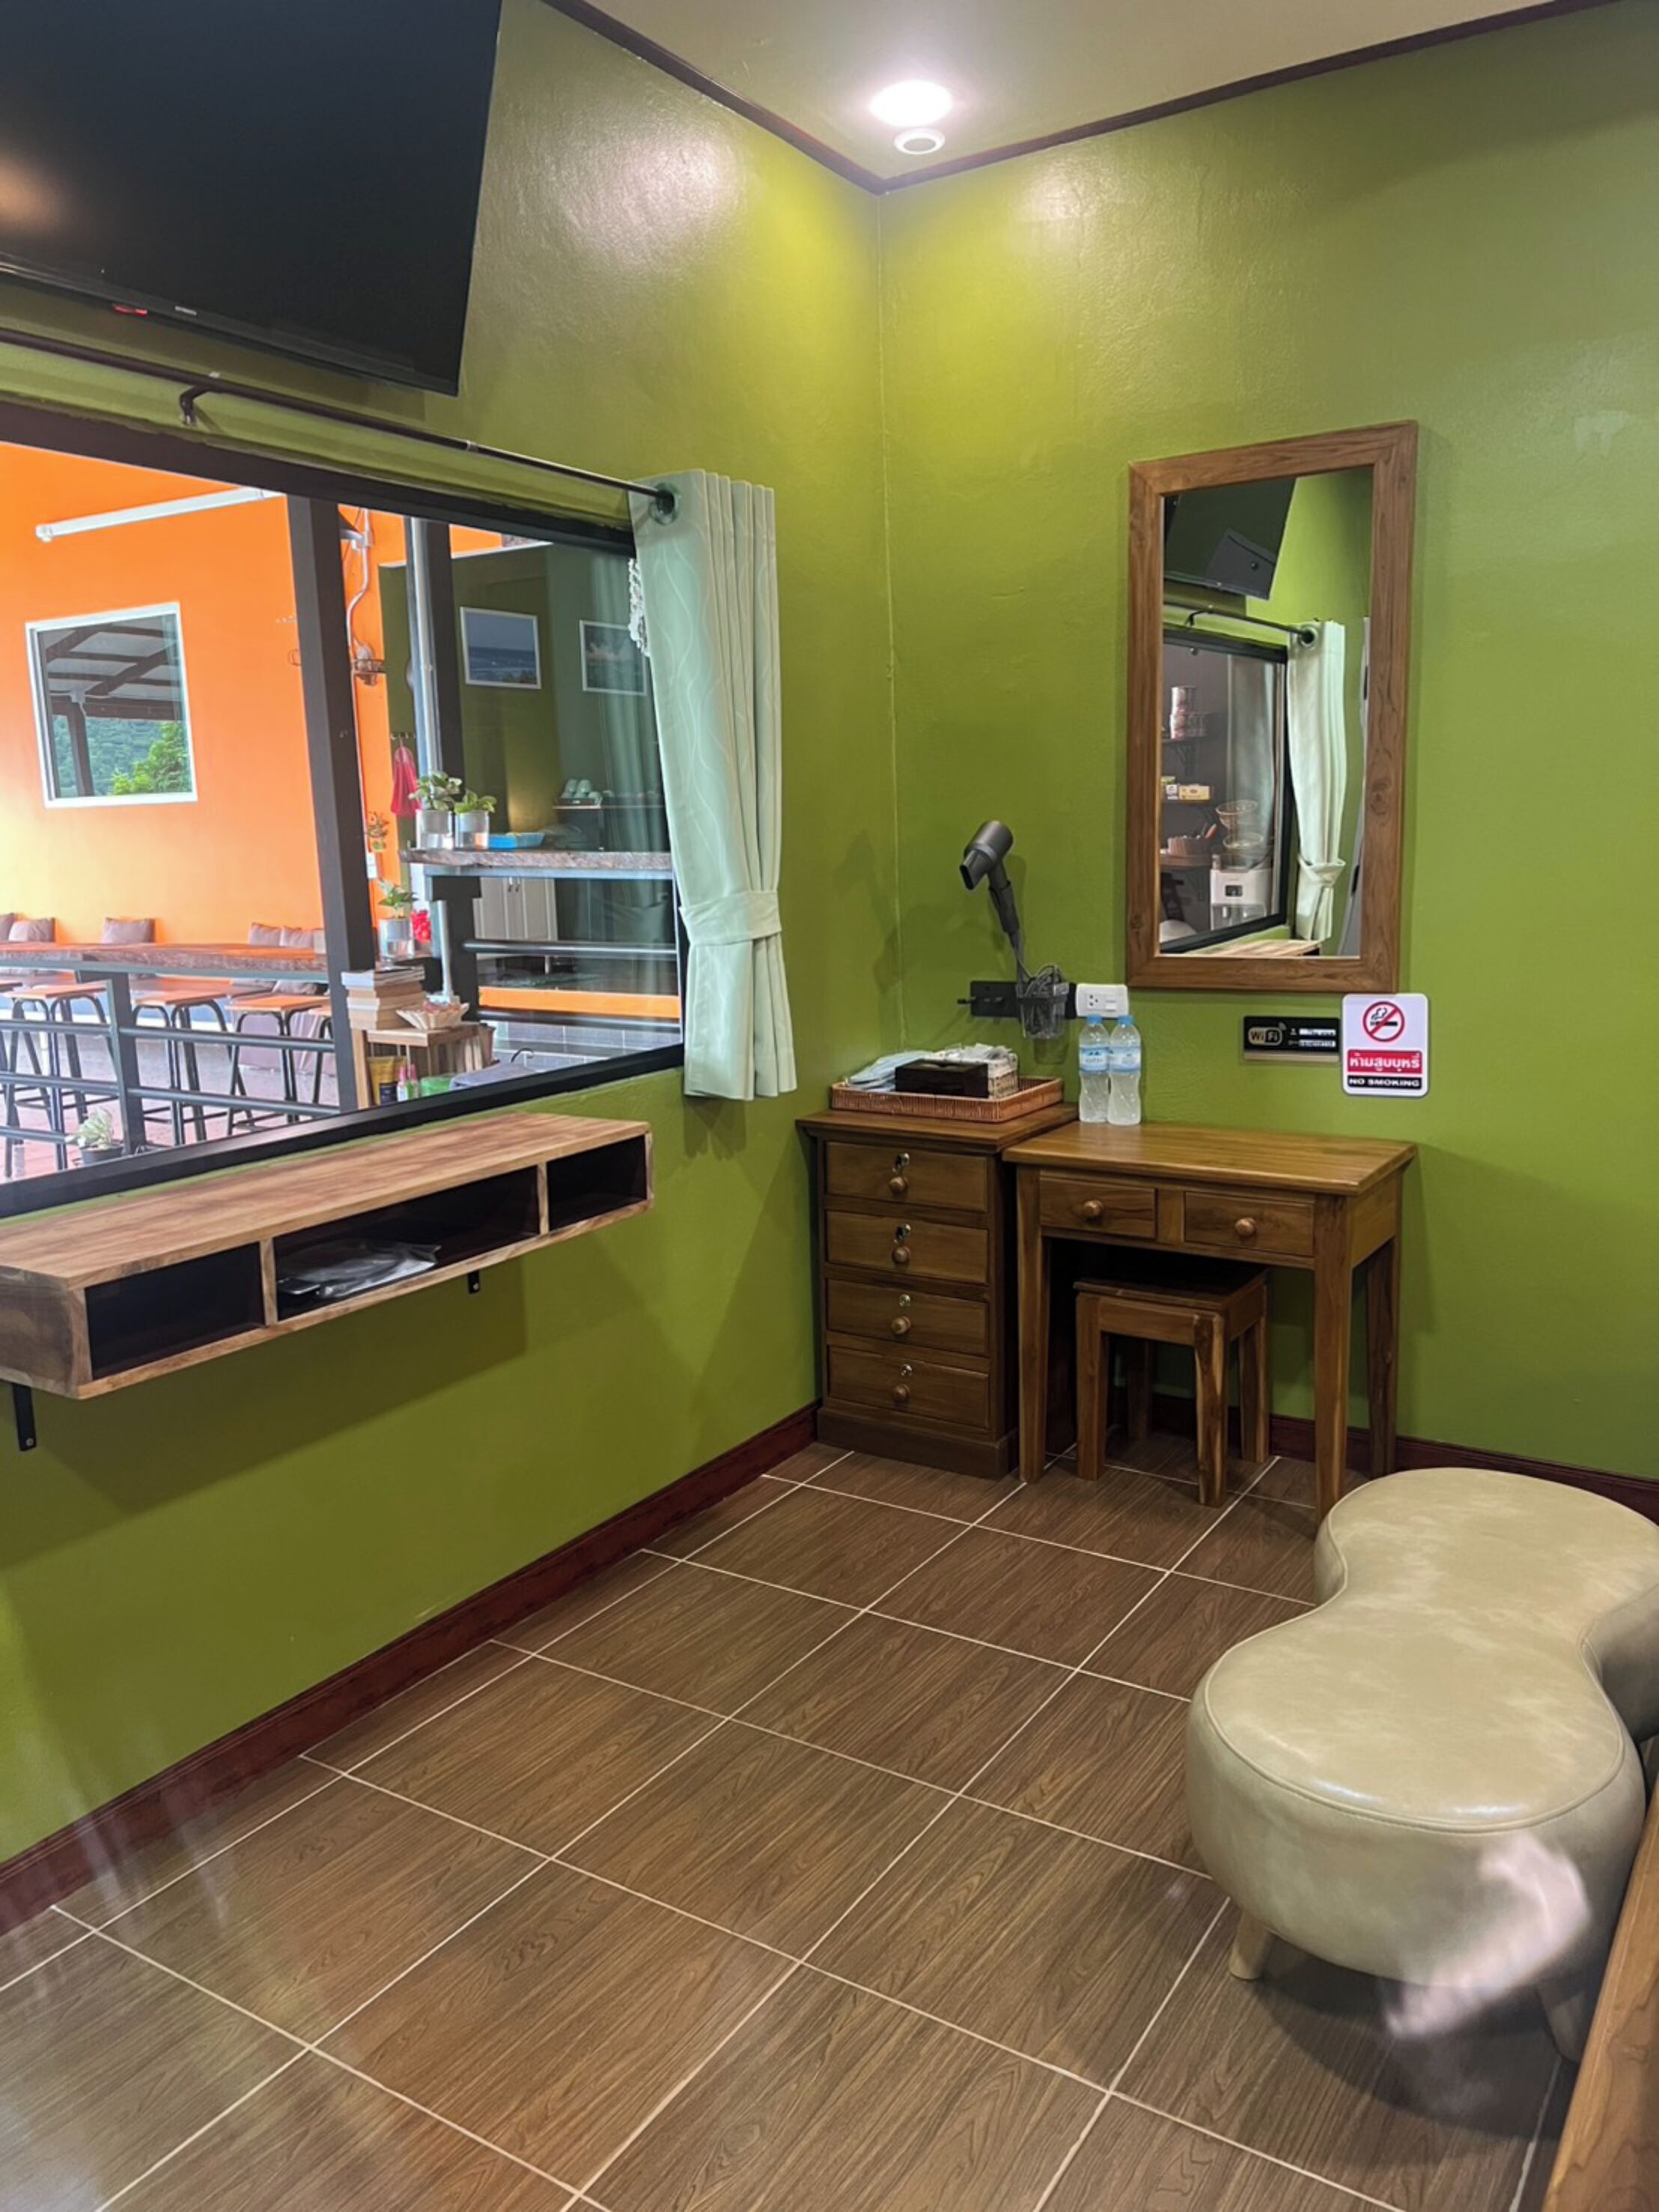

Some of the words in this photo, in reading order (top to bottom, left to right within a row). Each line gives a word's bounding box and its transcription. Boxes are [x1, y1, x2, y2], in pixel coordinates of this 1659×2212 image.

[1349, 1052, 1420, 1072] ห้ามสูบบุหรี่
[1367, 1078, 1420, 1087] SMOKING
